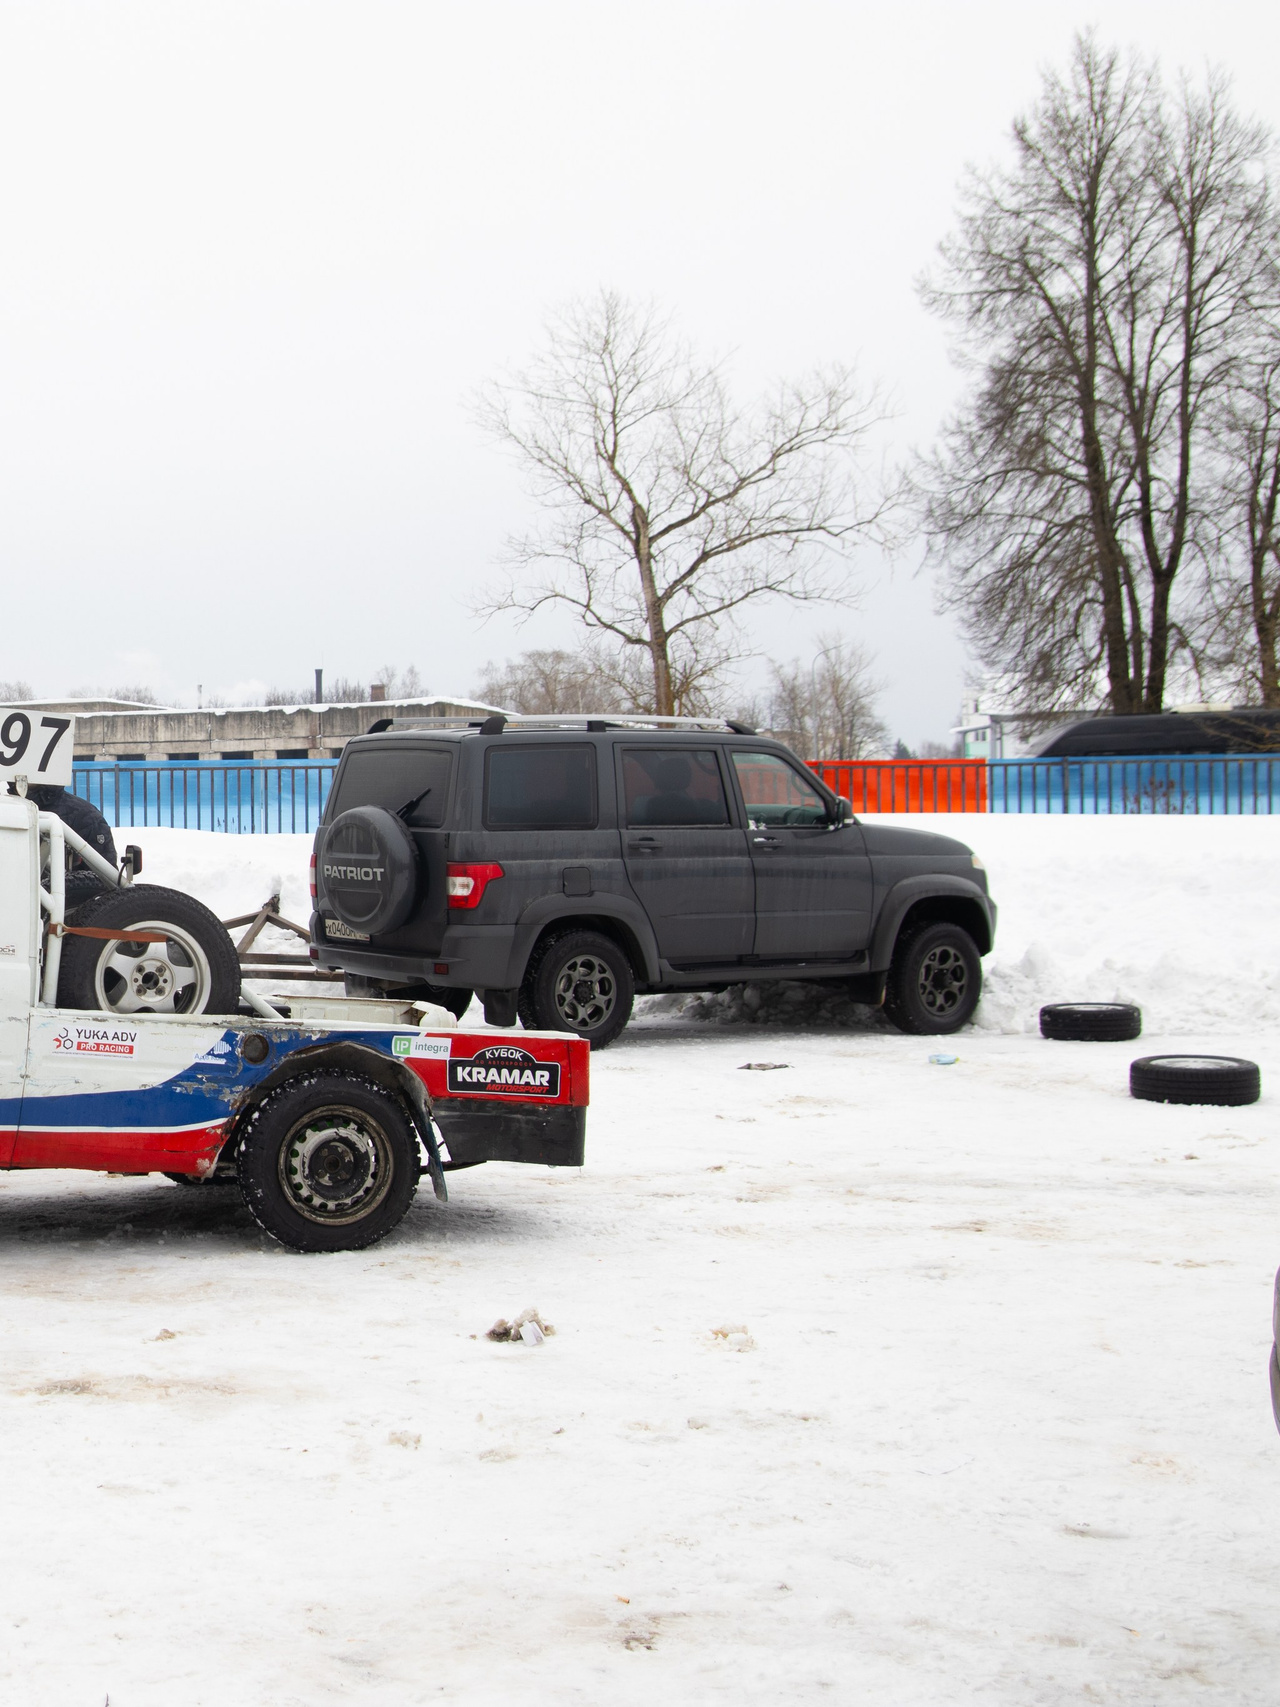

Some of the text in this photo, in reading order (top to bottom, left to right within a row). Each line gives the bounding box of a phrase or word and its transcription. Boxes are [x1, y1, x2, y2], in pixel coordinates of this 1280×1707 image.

[324, 864, 385, 882] PATRIOT
[76, 1028, 137, 1042] YUKA ADV
[80, 1043, 130, 1053] PRO RACING
[396, 1040, 449, 1054] IP integra
[485, 1048, 524, 1061] КУБОК
[456, 1066, 550, 1087] KRAMAR
[486, 1084, 550, 1094] MOTORSPORT
